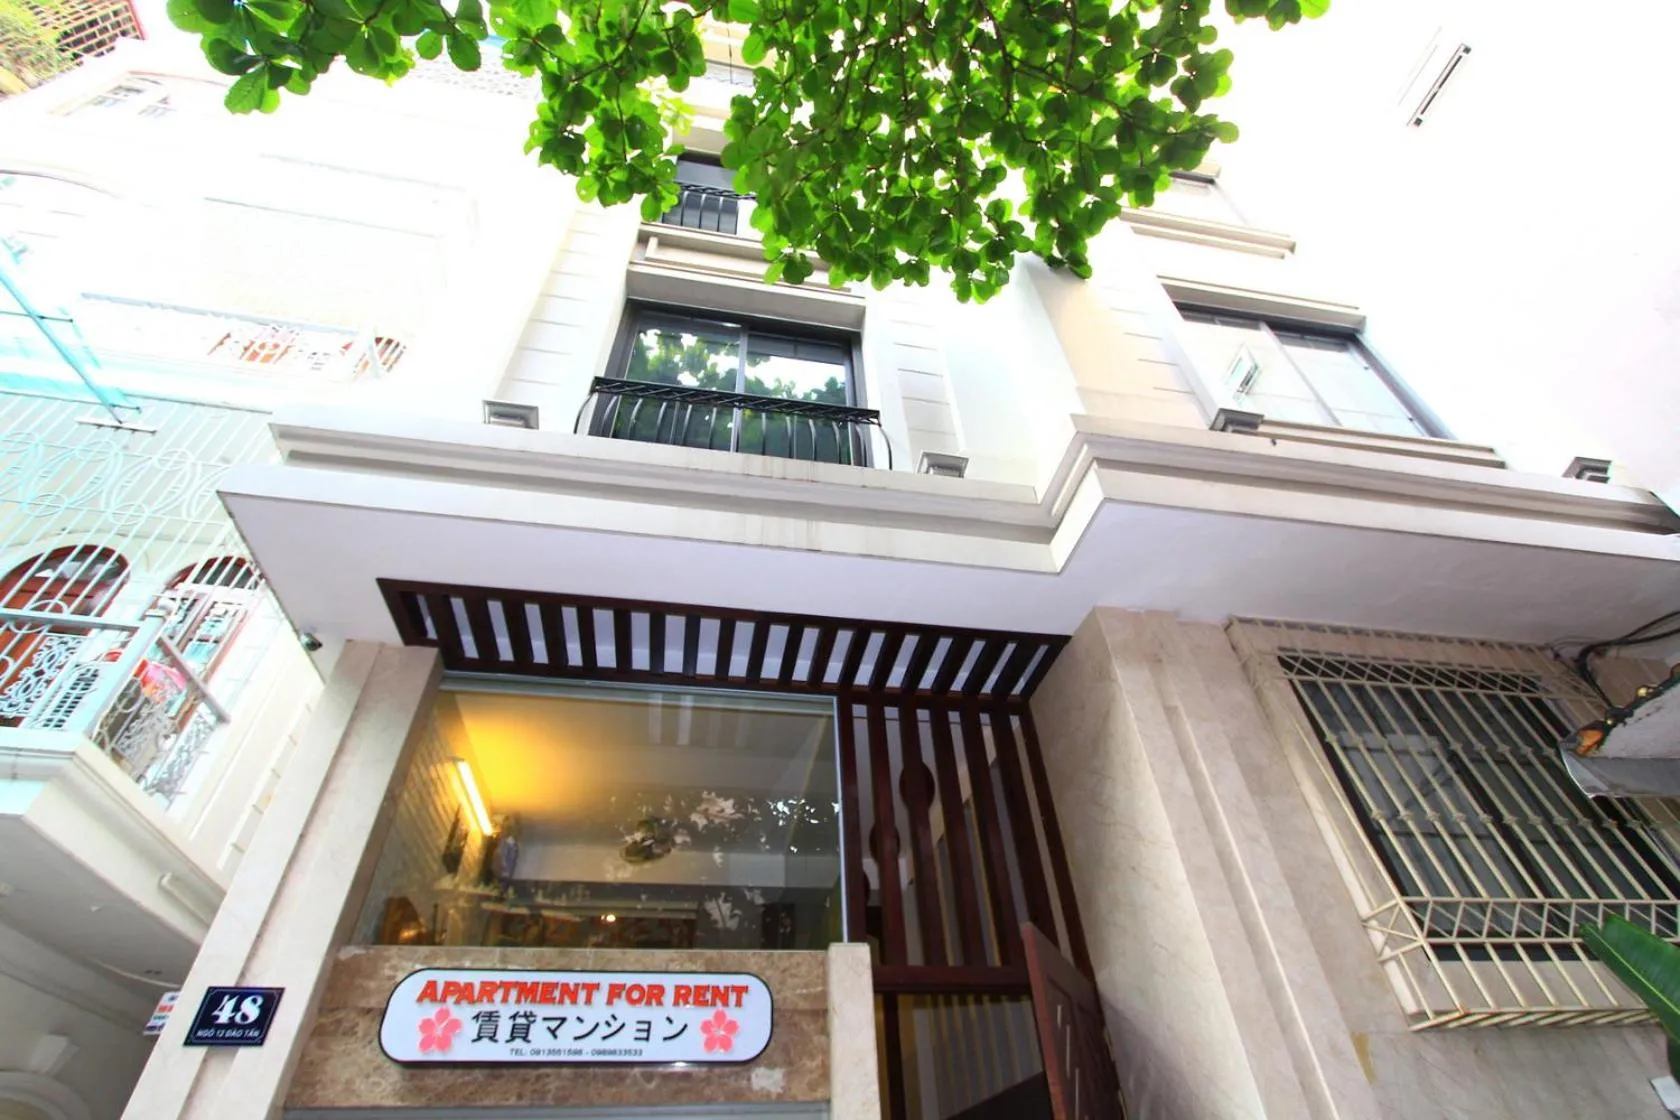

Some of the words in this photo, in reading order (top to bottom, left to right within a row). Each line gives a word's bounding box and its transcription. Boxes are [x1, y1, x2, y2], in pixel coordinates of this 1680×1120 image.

[212, 994, 264, 1025] 48
[416, 980, 600, 1005] APARTMENT
[606, 983, 666, 1007] FOR
[672, 984, 749, 1008] RENT
[471, 1010, 688, 1044] 賃貸マンション
